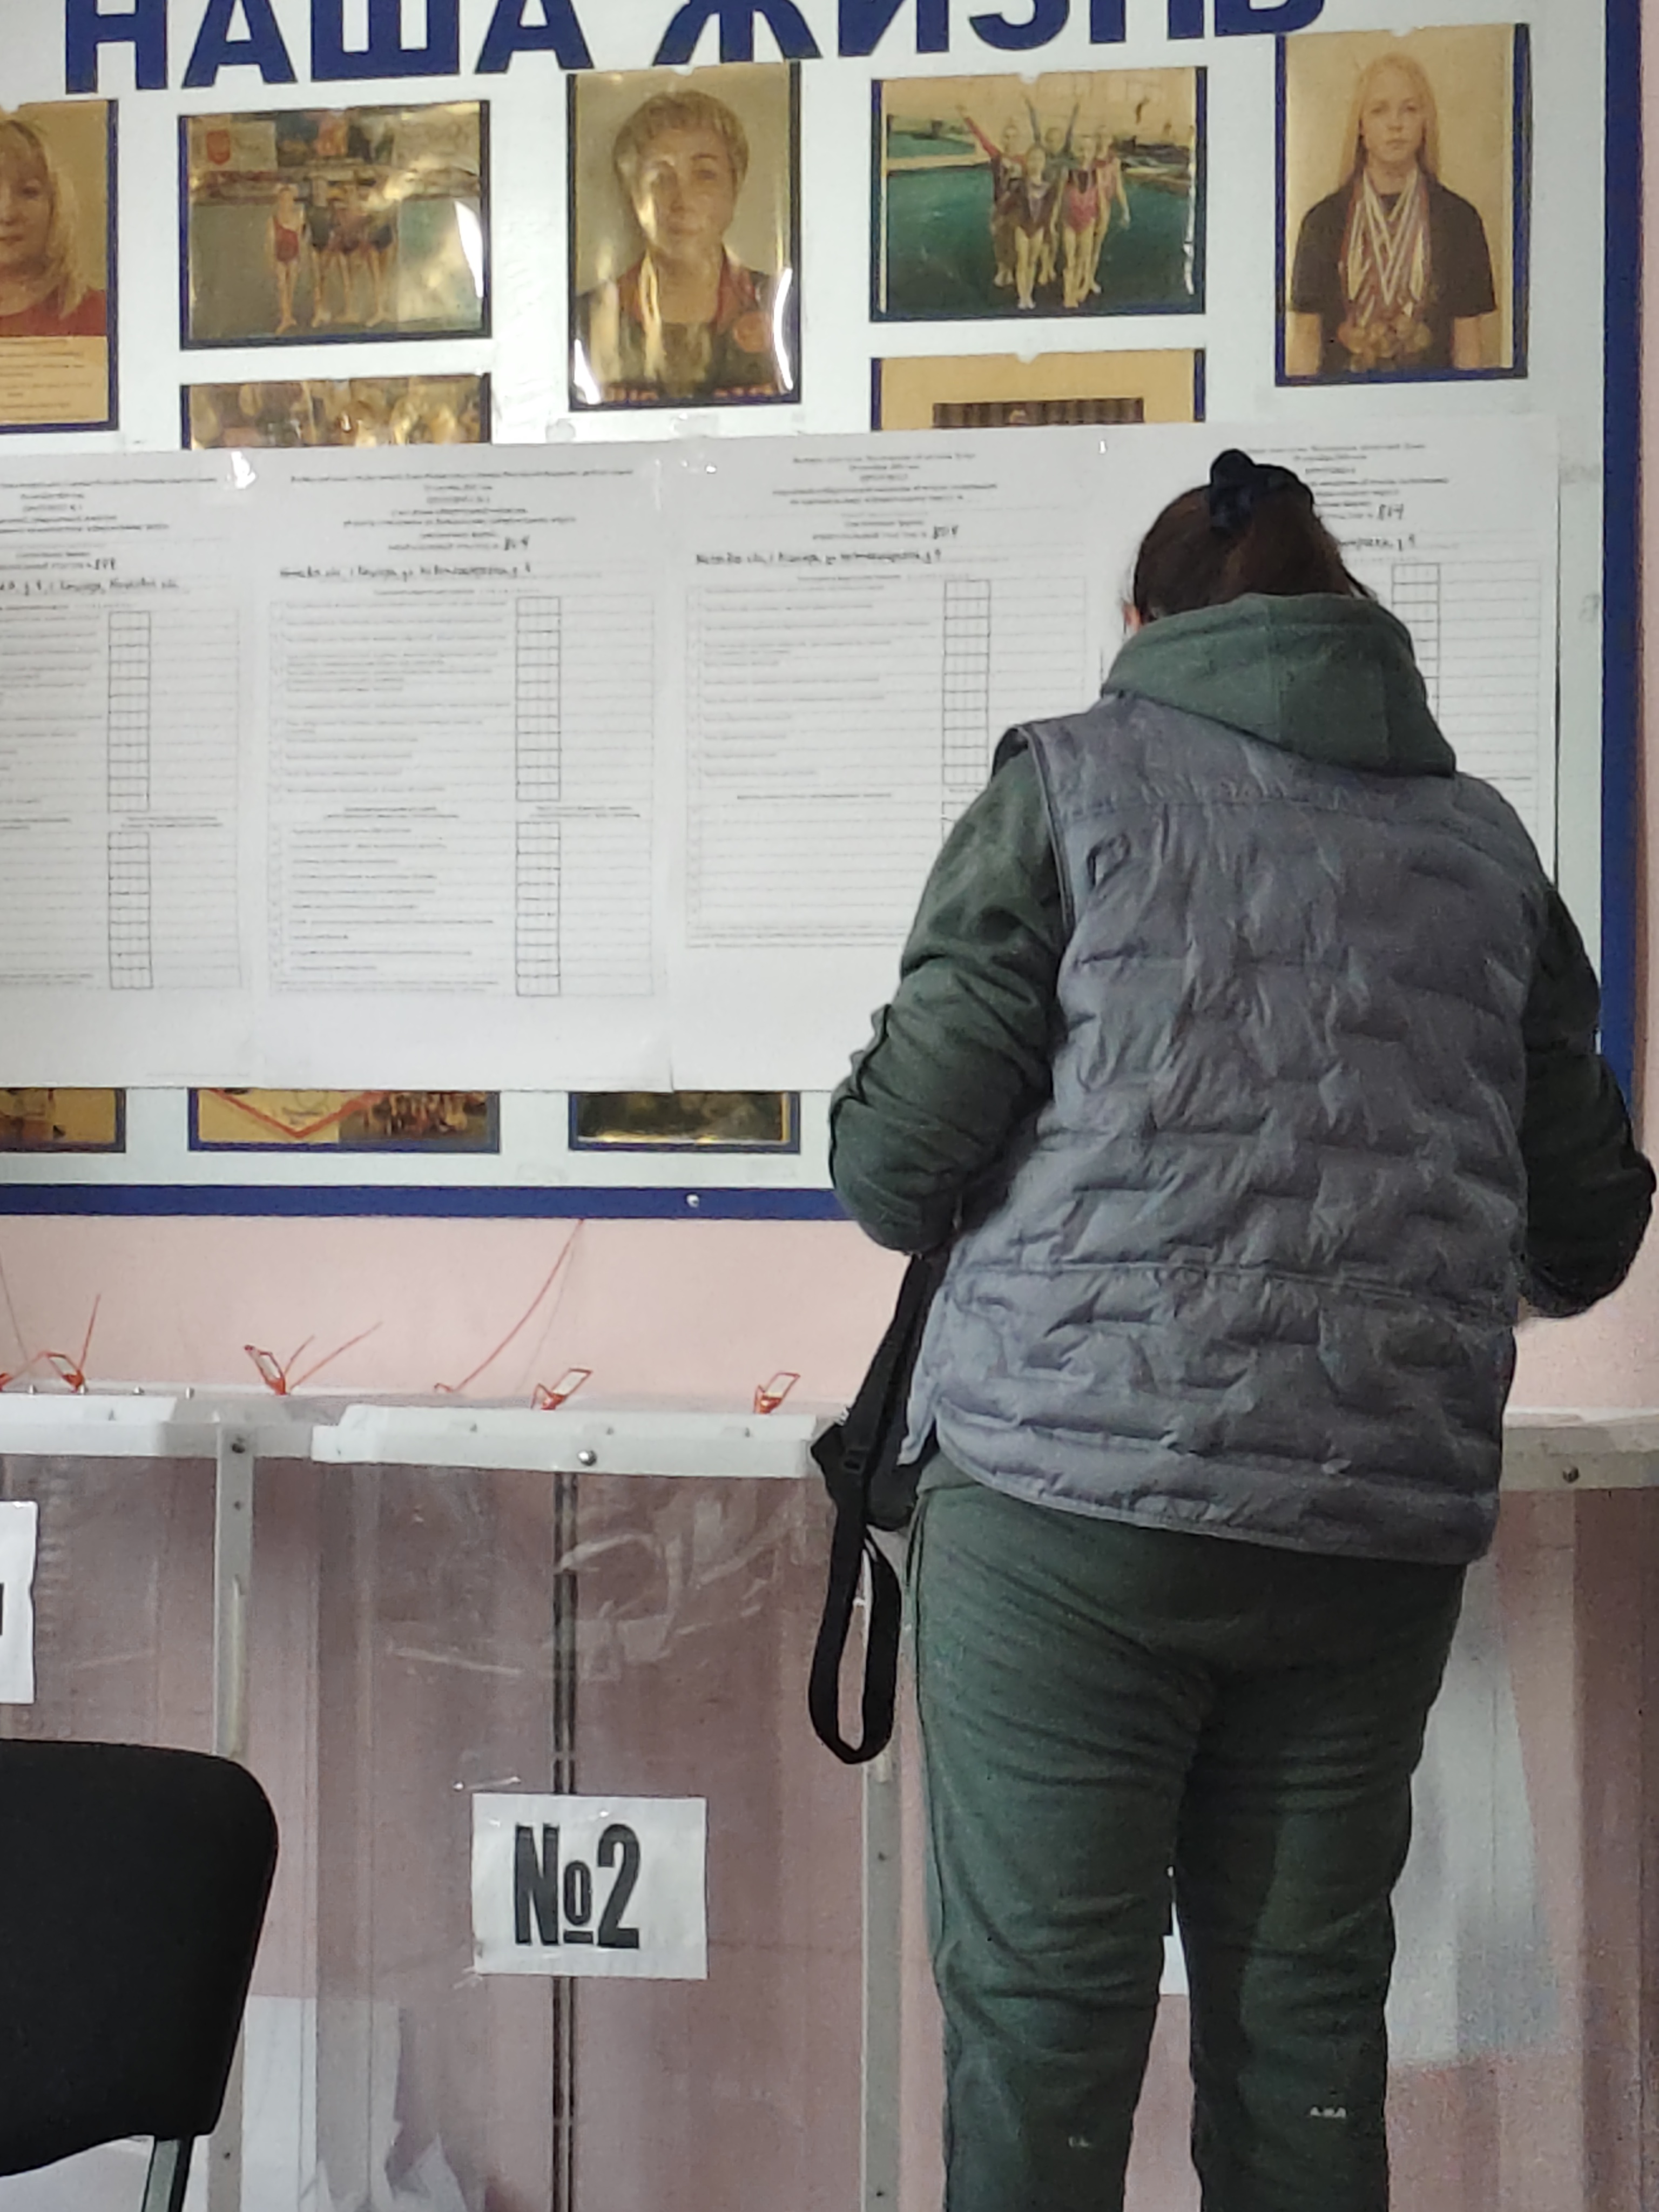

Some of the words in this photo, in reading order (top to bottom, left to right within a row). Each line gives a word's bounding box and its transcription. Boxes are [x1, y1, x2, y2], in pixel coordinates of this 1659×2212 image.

[65, 0, 595, 93] НАША
[652, 0, 1324, 65] ЖИЗ
[515, 1823, 640, 1949] №2
